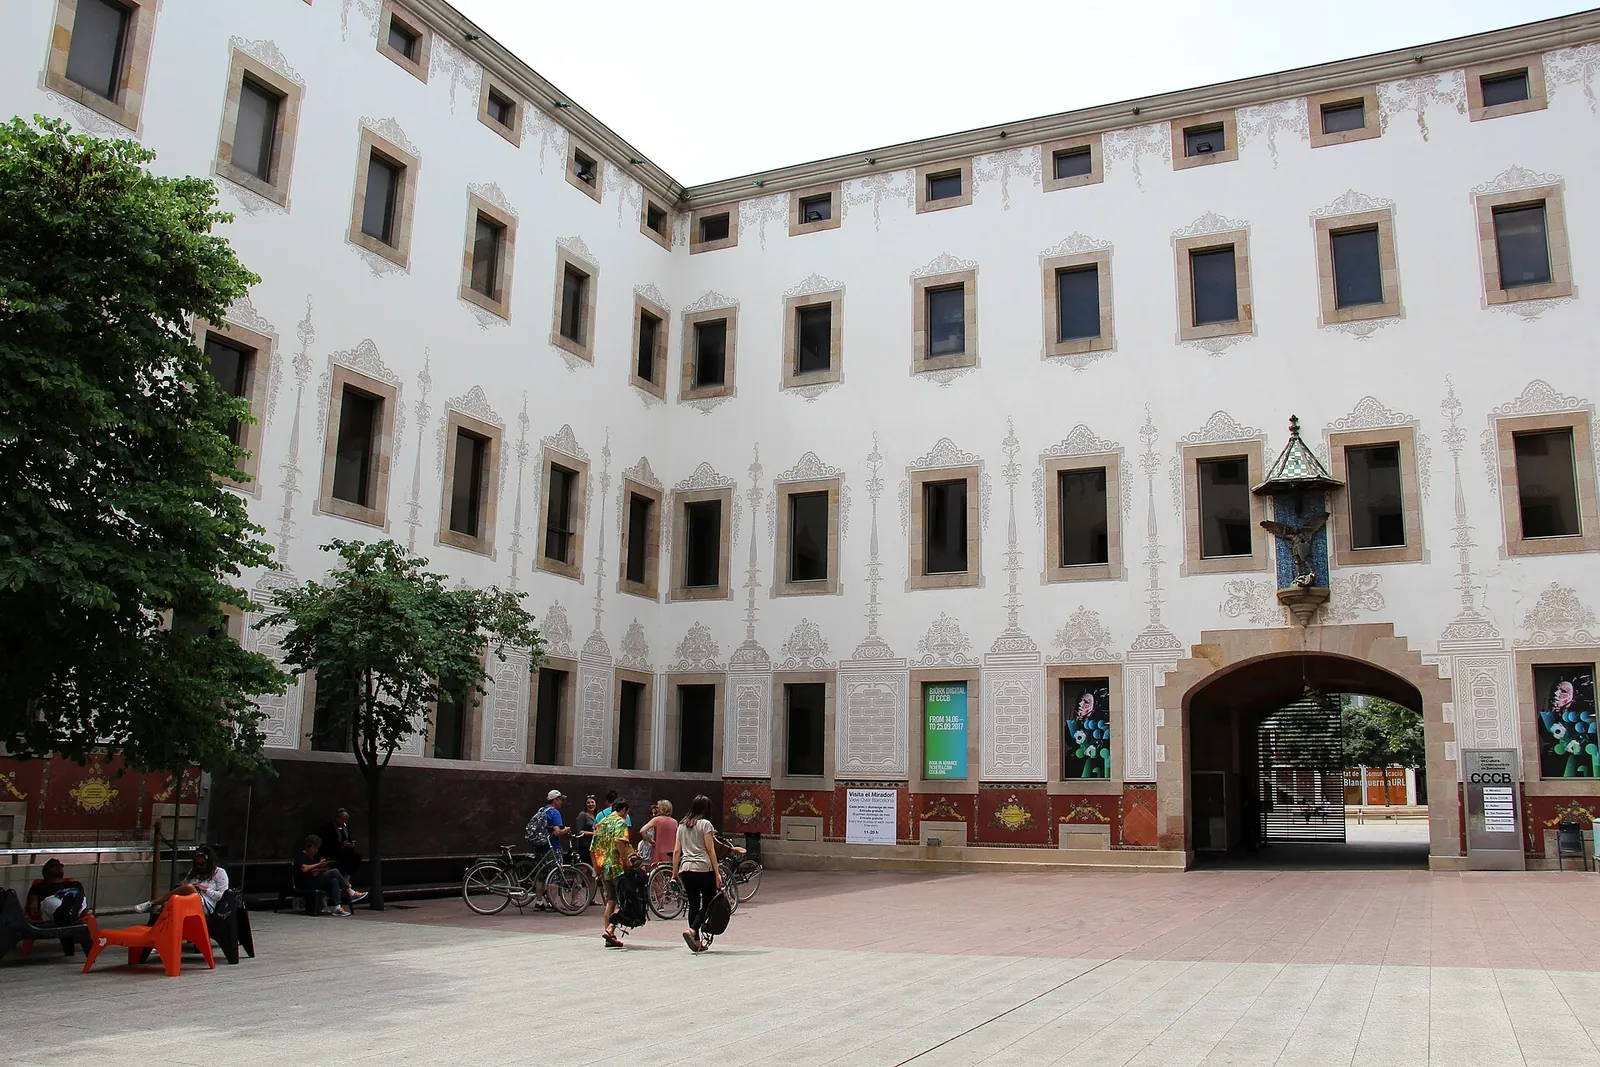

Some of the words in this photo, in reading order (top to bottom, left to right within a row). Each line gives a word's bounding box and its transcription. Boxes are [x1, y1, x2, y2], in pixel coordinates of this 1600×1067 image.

[930, 686, 946, 694] BJÖRK
[946, 687, 965, 695] DIGITAL
[1392, 779, 1406, 787] URL
[1471, 773, 1511, 784] CCCB
